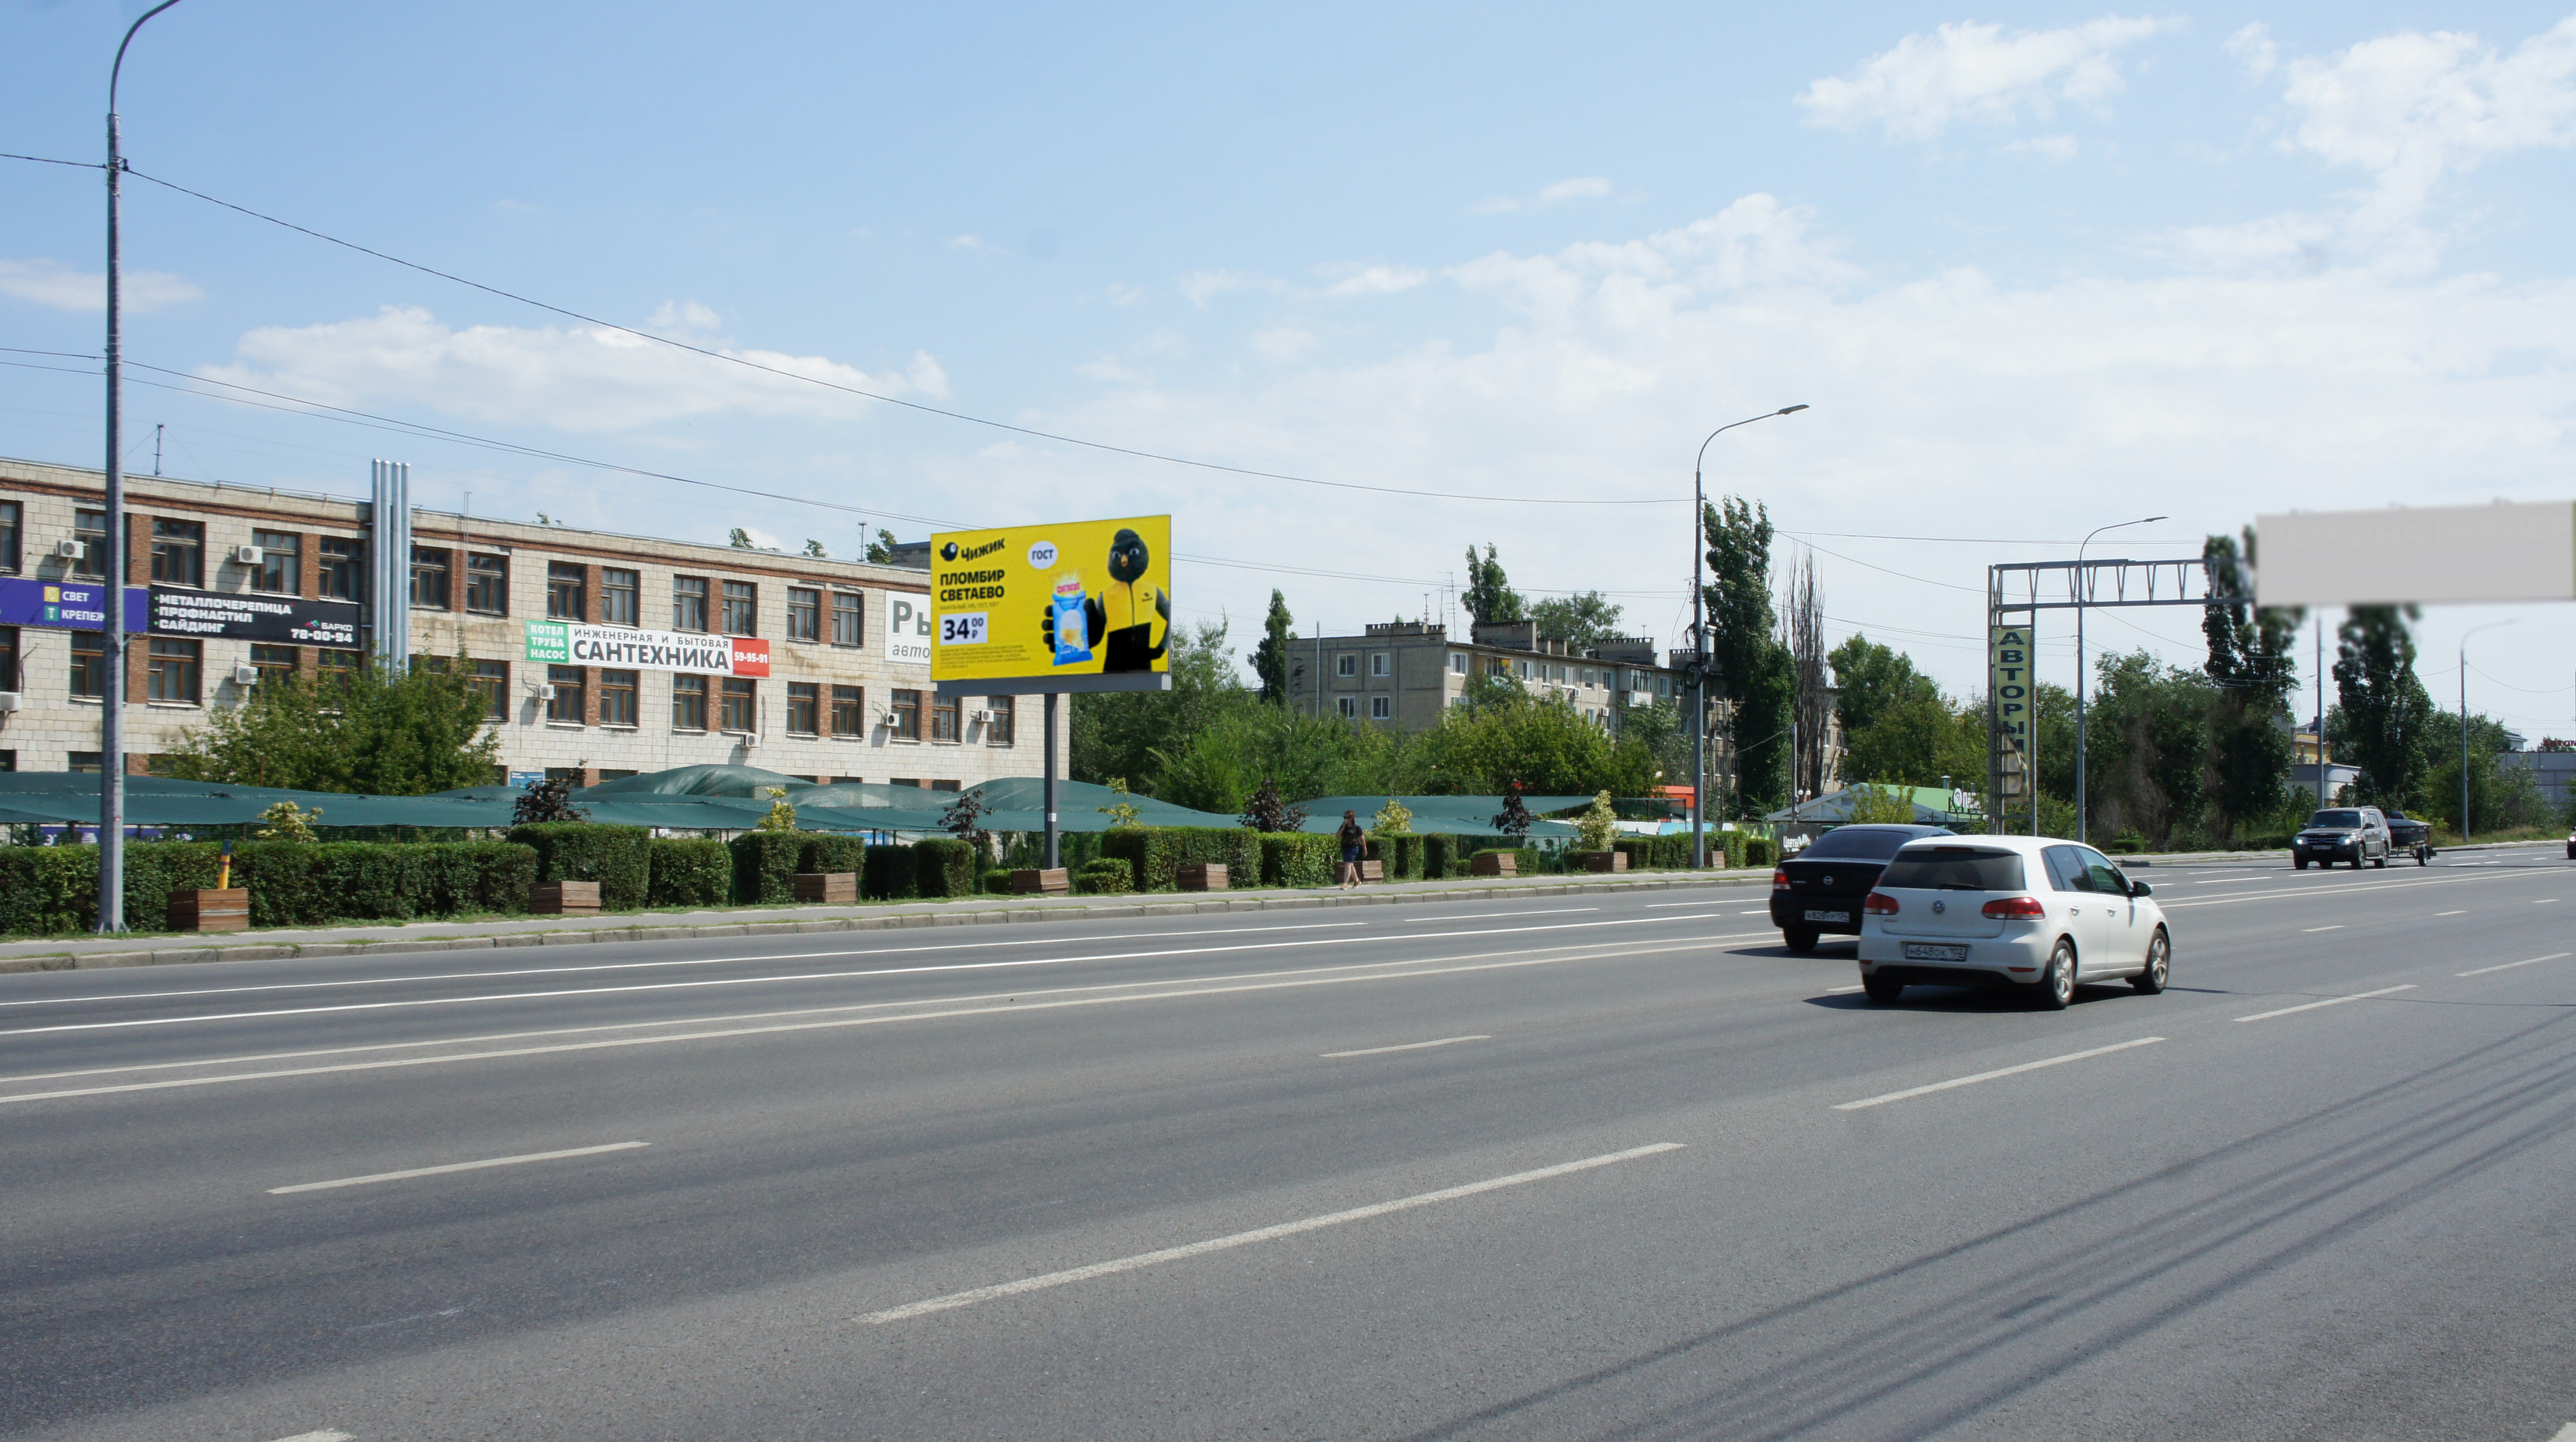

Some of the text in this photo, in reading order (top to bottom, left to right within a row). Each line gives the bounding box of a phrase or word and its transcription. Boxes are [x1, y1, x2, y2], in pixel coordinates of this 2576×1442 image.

[961, 538, 1005, 562] Чижик
[1031, 549, 1054, 561] ГОСТ
[941, 569, 1005, 586] ПЛОМБИР
[62, 591, 90, 602] СВЕТ
[940, 585, 1005, 602] СВЕТАЕВО
[159, 594, 292, 615] МЕТАЛЛОЧЕРЕПИЦА
[62, 609, 105, 622] КРЕПЕЖ
[159, 606, 253, 623] ПРОФНАСТИЛ
[159, 619, 225, 633] САЙДИНГ
[321, 622, 353, 632] БАРКО
[531, 625, 564, 635] КОТЕЛ
[944, 617, 984, 640] 34 00
[290, 629, 353, 642] 78-00-94
[531, 637, 565, 648] ТРУБА
[574, 629, 729, 649] ИНЖЕНЕРНАЯ И БЫТОВАЯ
[531, 649, 565, 660] НАСОС
[573, 640, 730, 669] САНТЕХНИКА
[734, 652, 768, 663] 59-95-91
[1998, 632, 2025, 783] АВТОРЫ
